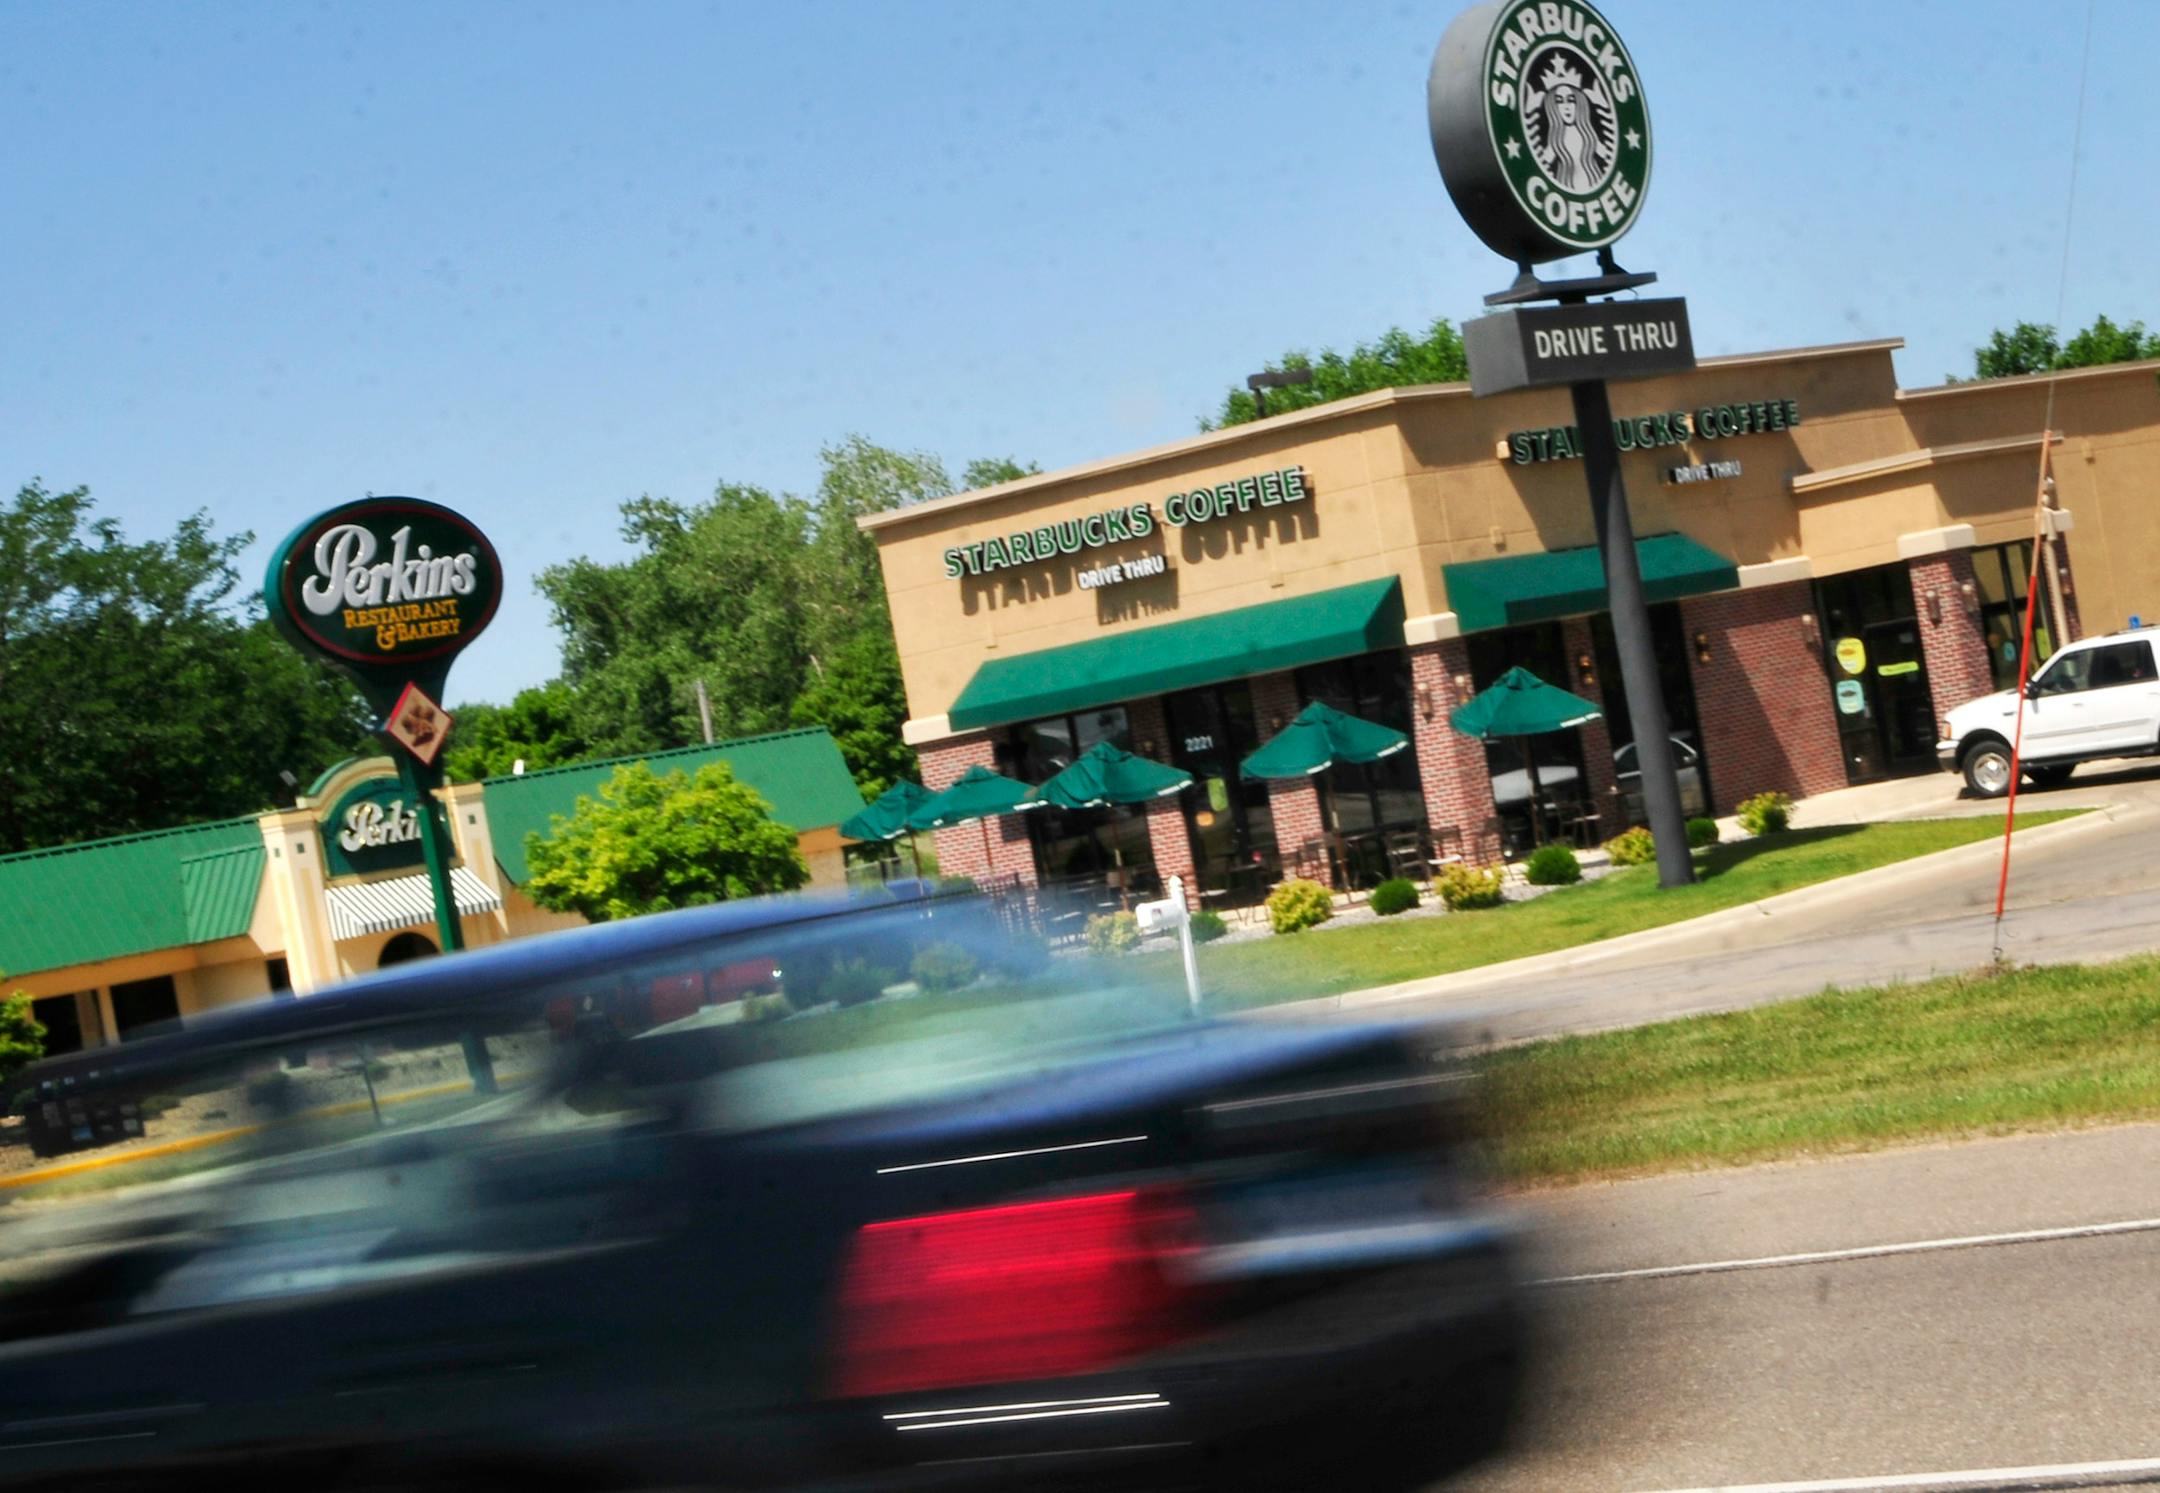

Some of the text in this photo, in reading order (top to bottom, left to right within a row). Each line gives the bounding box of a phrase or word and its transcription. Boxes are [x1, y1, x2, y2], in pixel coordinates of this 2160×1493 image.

[1491, 2, 1636, 110] STARBUCKS
[1526, 170, 1637, 235] COFFEE
[1534, 320, 1679, 360] DRIVE THRU
[1511, 399, 1800, 466] STAUCKS COFFEE
[1674, 460, 1743, 485] DRIVE THRU
[943, 464, 1307, 580] STARBUCKS COFFEE
[302, 524, 477, 616] Perkins
[1077, 554, 1166, 590] DRIVE THRU
[343, 599, 459, 629] RESTAURANT
[340, 799, 446, 853] Perki
